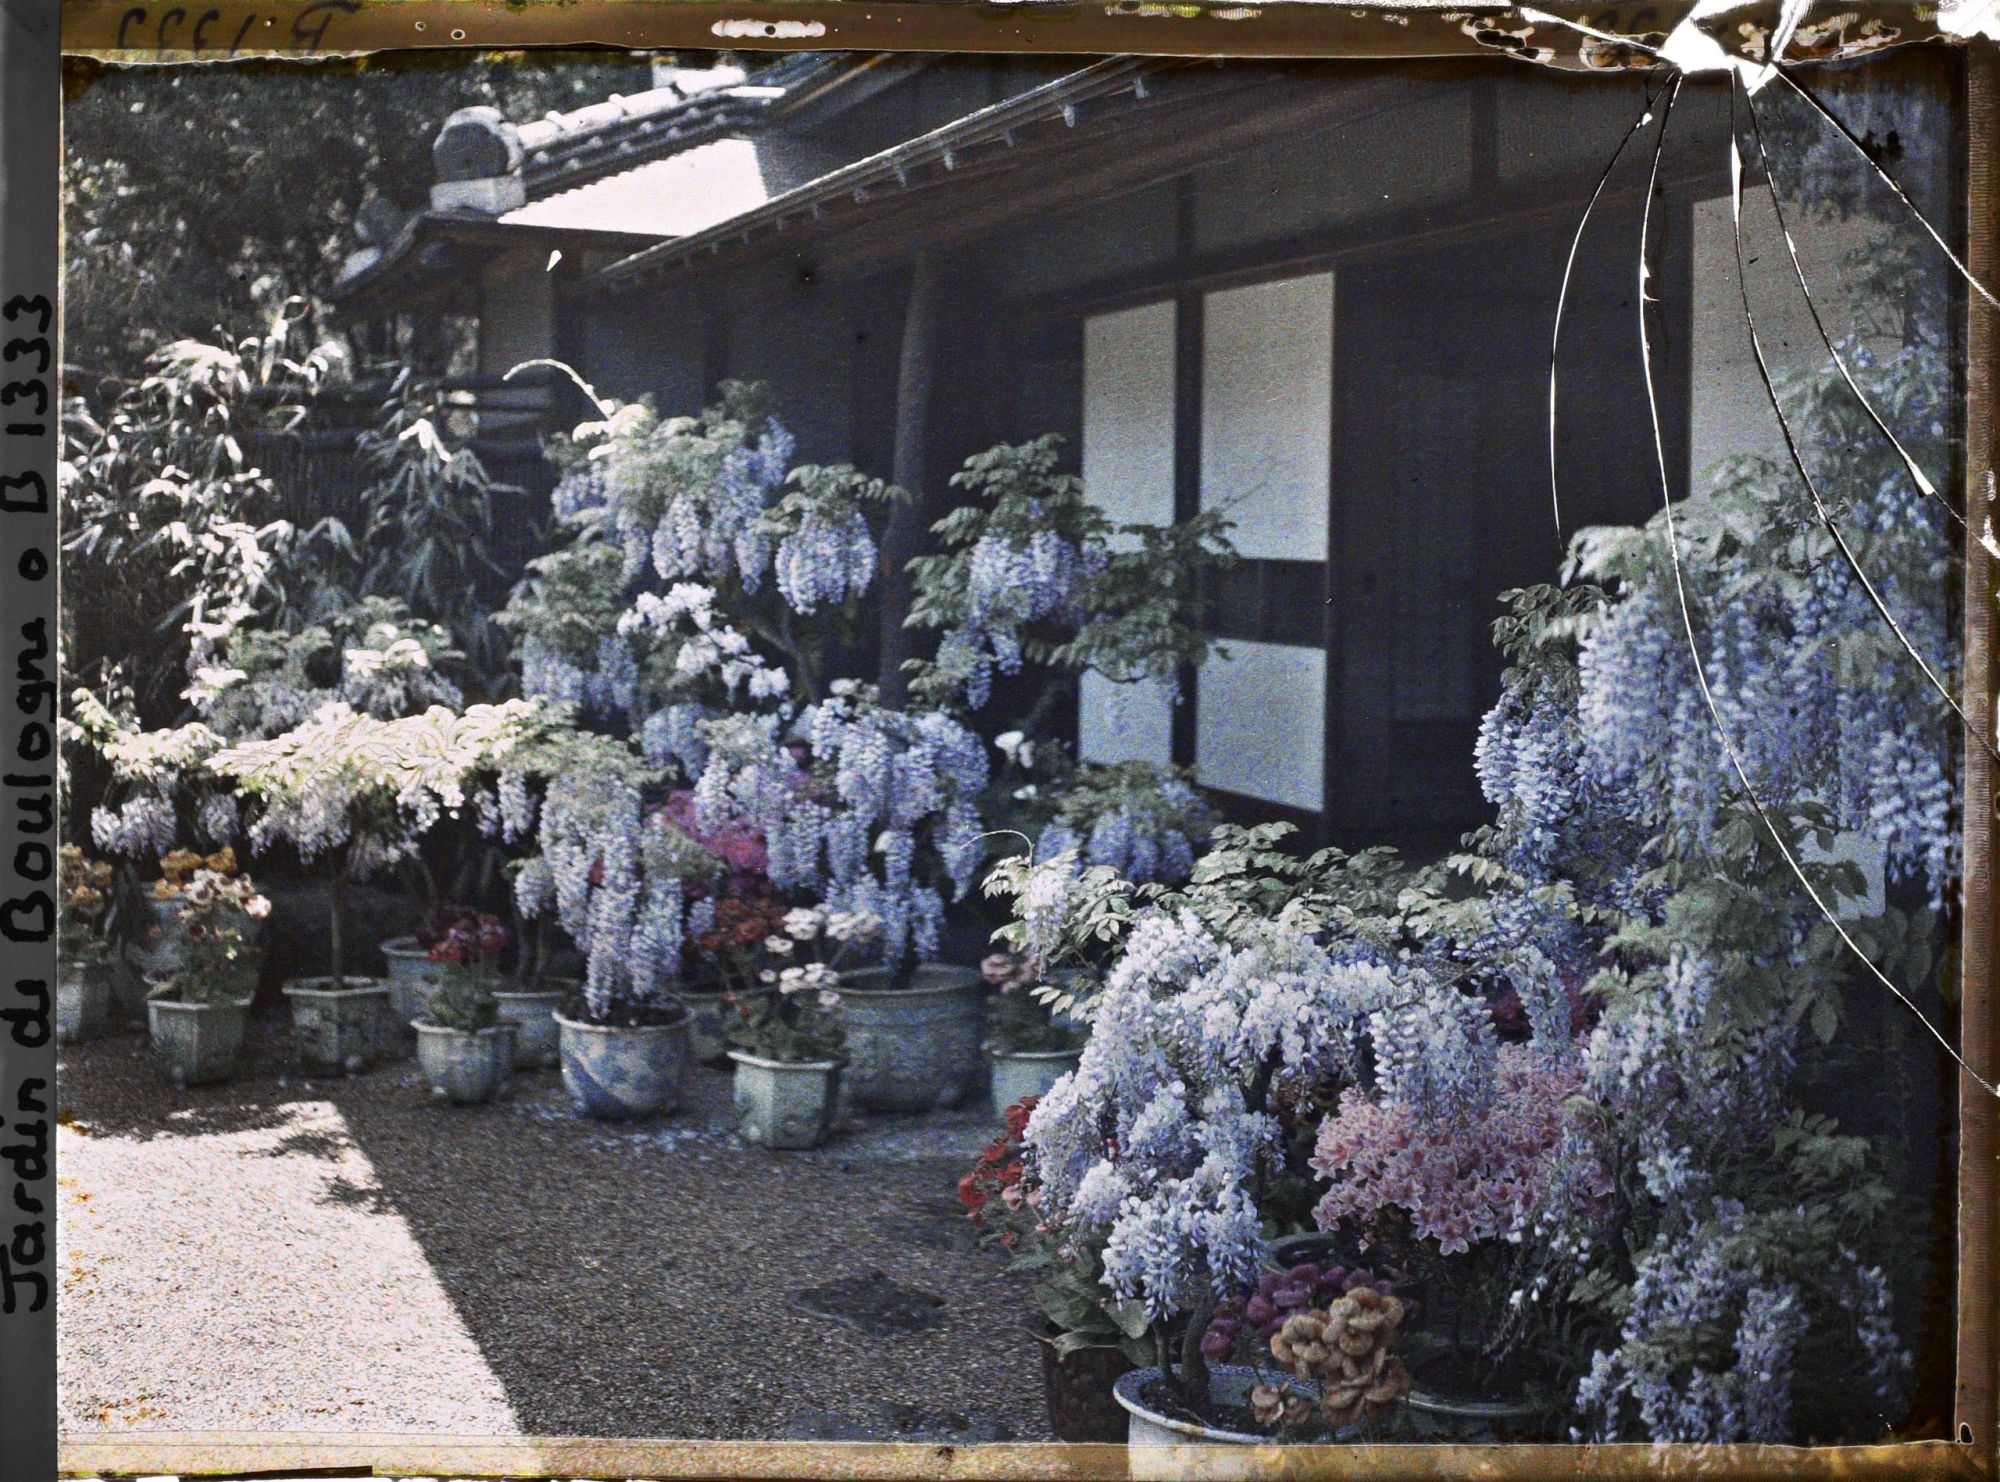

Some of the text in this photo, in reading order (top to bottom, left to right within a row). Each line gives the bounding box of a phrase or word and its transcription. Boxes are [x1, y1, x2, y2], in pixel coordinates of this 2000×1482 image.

[0, 293, 52, 437] 1333
[0, 470, 49, 514] B
[0, 617, 56, 942] Boulogne
[0, 1078, 48, 1314] Jardin
